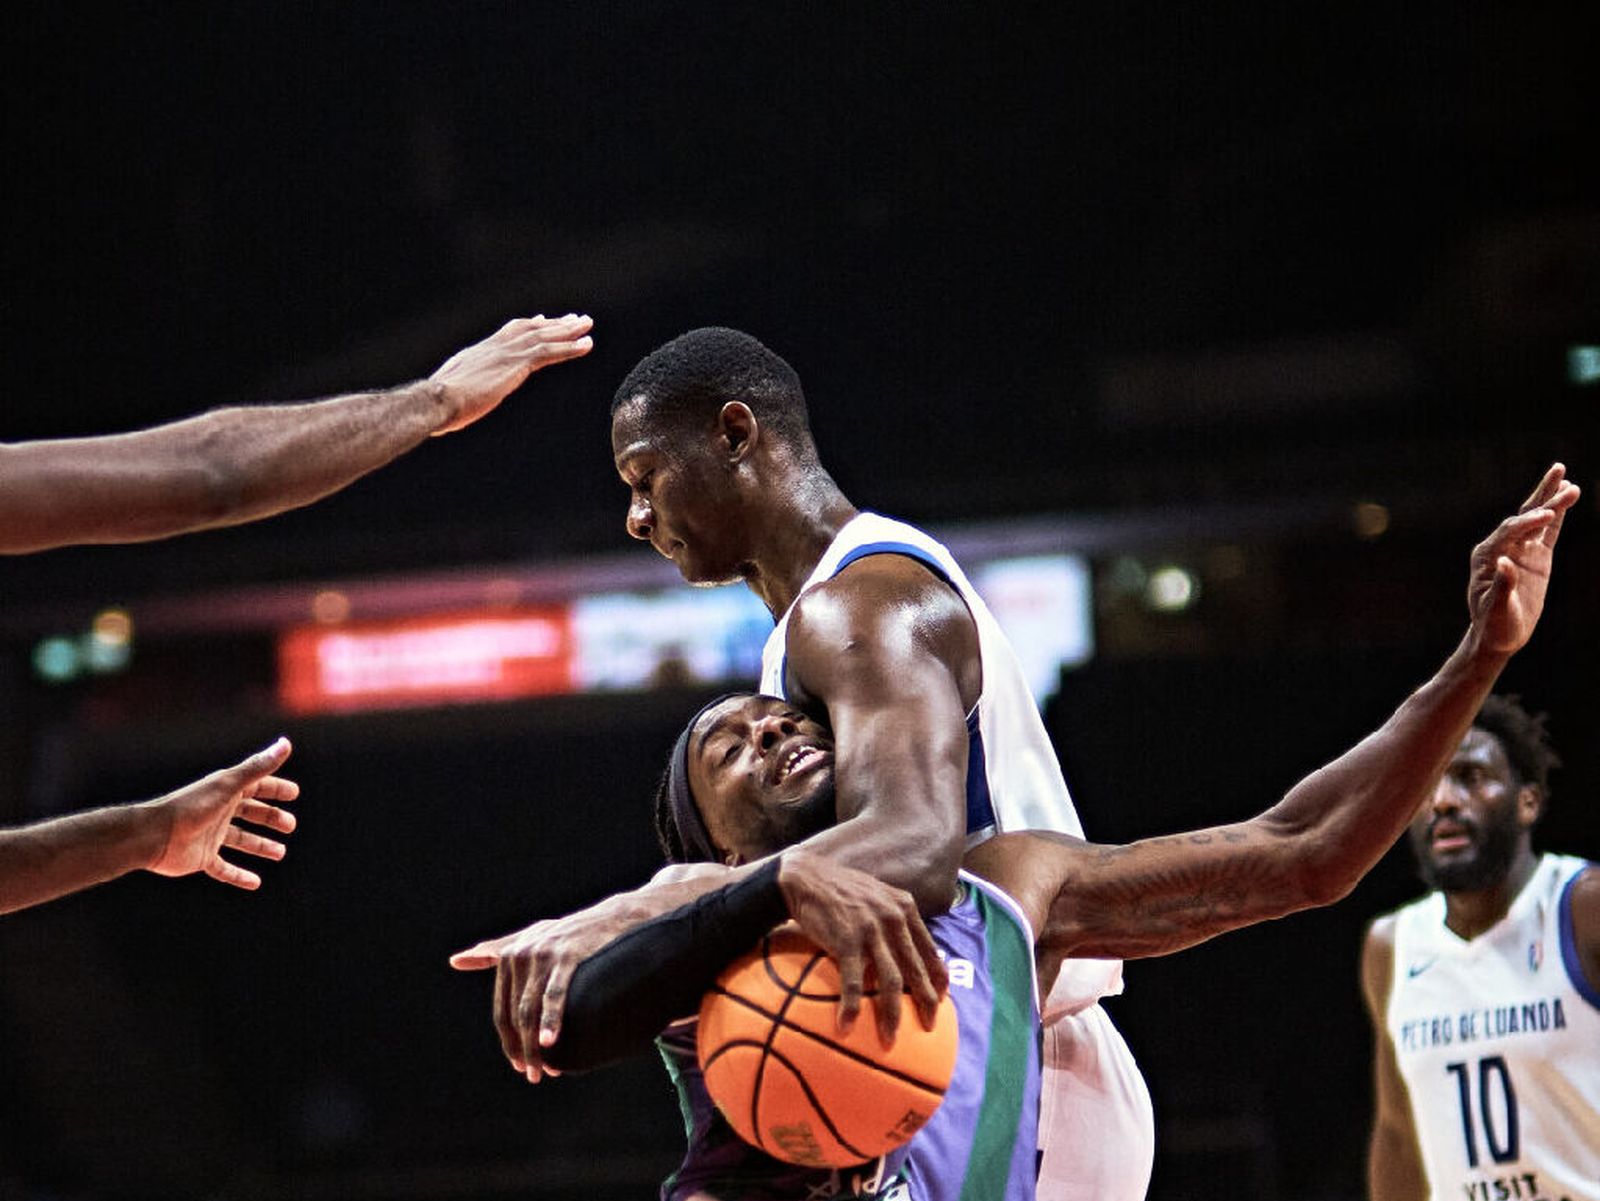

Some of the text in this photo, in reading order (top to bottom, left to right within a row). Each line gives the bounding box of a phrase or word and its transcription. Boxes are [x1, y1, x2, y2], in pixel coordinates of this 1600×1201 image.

[1401, 998, 1567, 1050] PETRO DE LUANDA
[1446, 1055, 1520, 1168] 10
